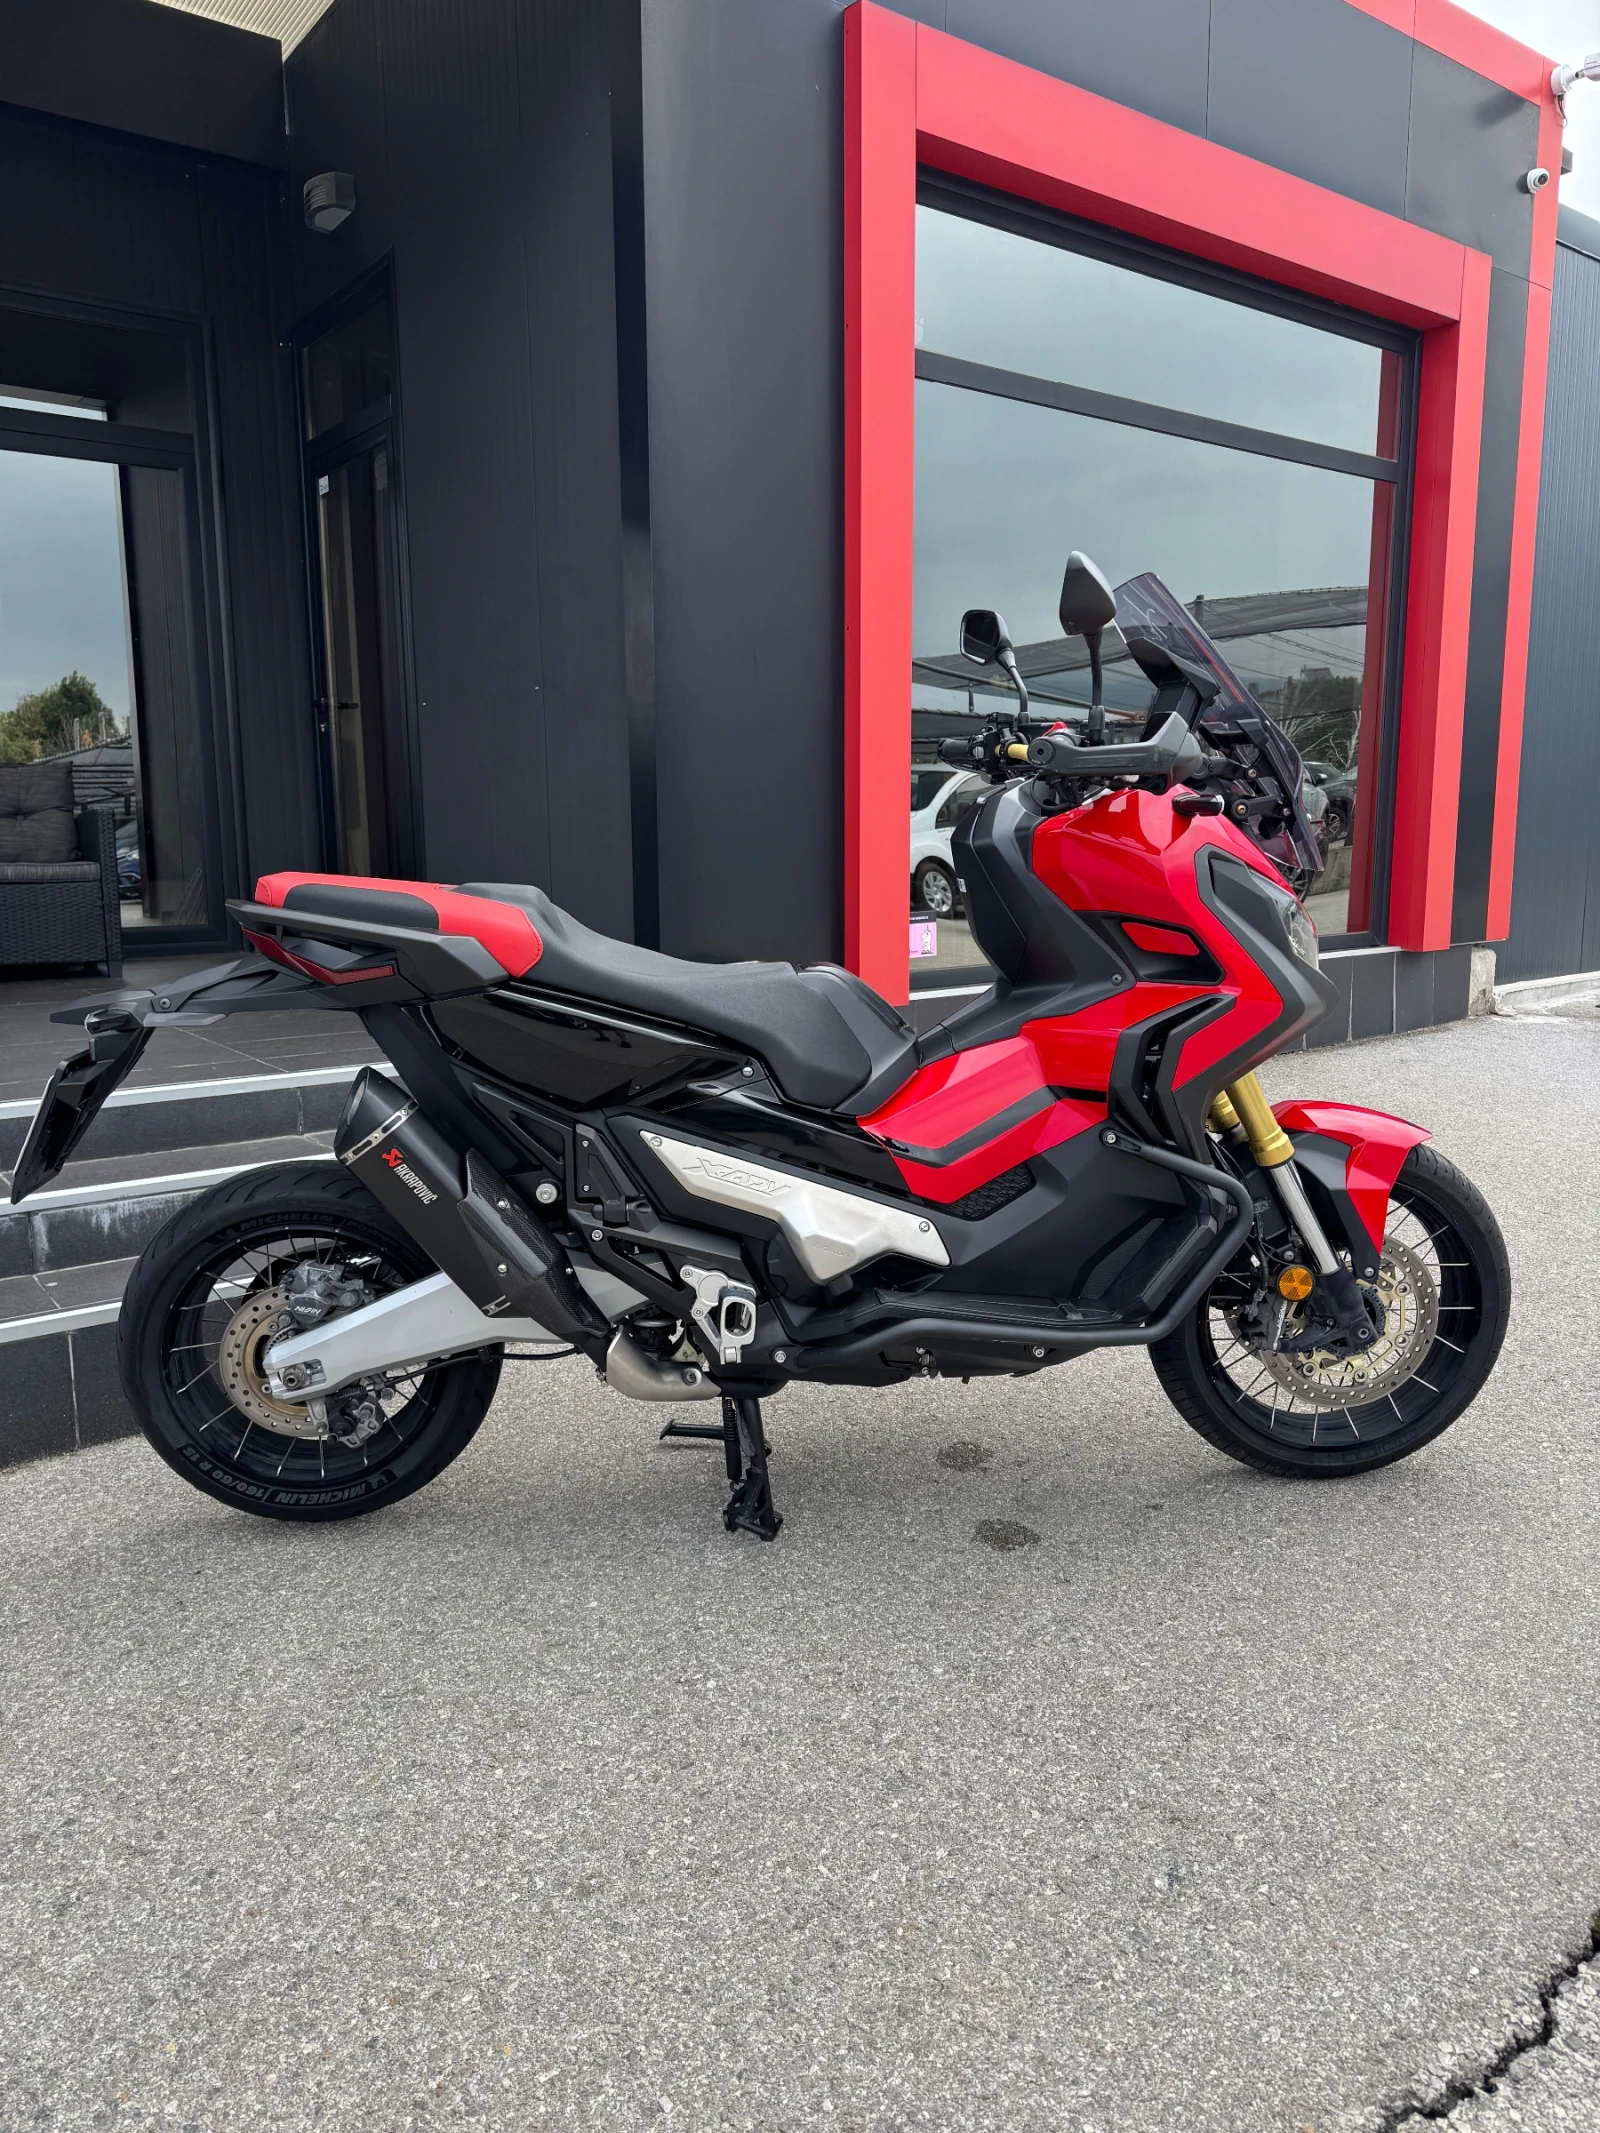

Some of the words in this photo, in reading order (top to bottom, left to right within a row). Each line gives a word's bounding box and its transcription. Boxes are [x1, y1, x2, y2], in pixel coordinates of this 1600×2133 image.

[240, 1213, 334, 1232] MICHELIN
[212, 1470, 266, 1498] 160/60
[275, 1483, 366, 1503] MICHELIN
